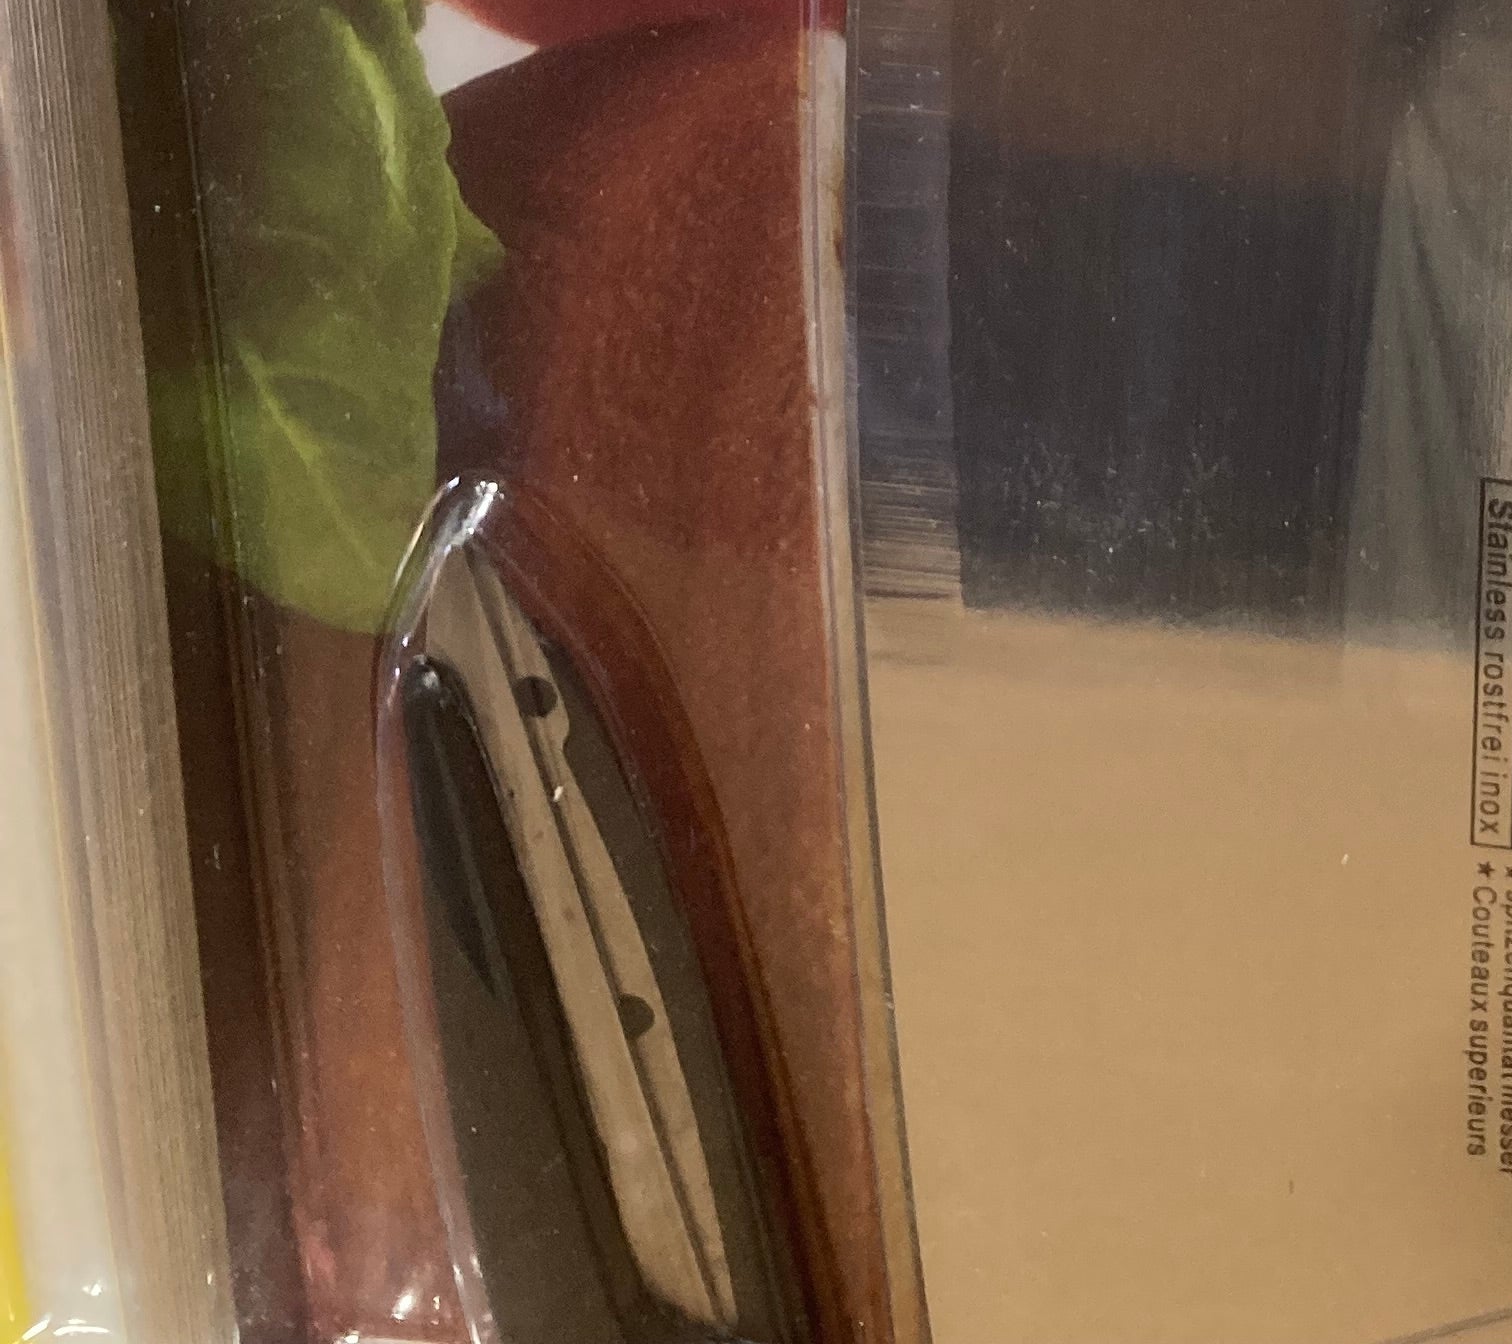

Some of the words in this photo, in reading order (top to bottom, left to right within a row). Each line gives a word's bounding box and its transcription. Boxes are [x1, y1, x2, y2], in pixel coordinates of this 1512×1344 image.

[1480, 650, 1509, 764] rostfrei
[1479, 768, 1508, 835] inox
[1470, 886, 1498, 1013] Couteaux
[1463, 1019, 1494, 1157] superieurs
